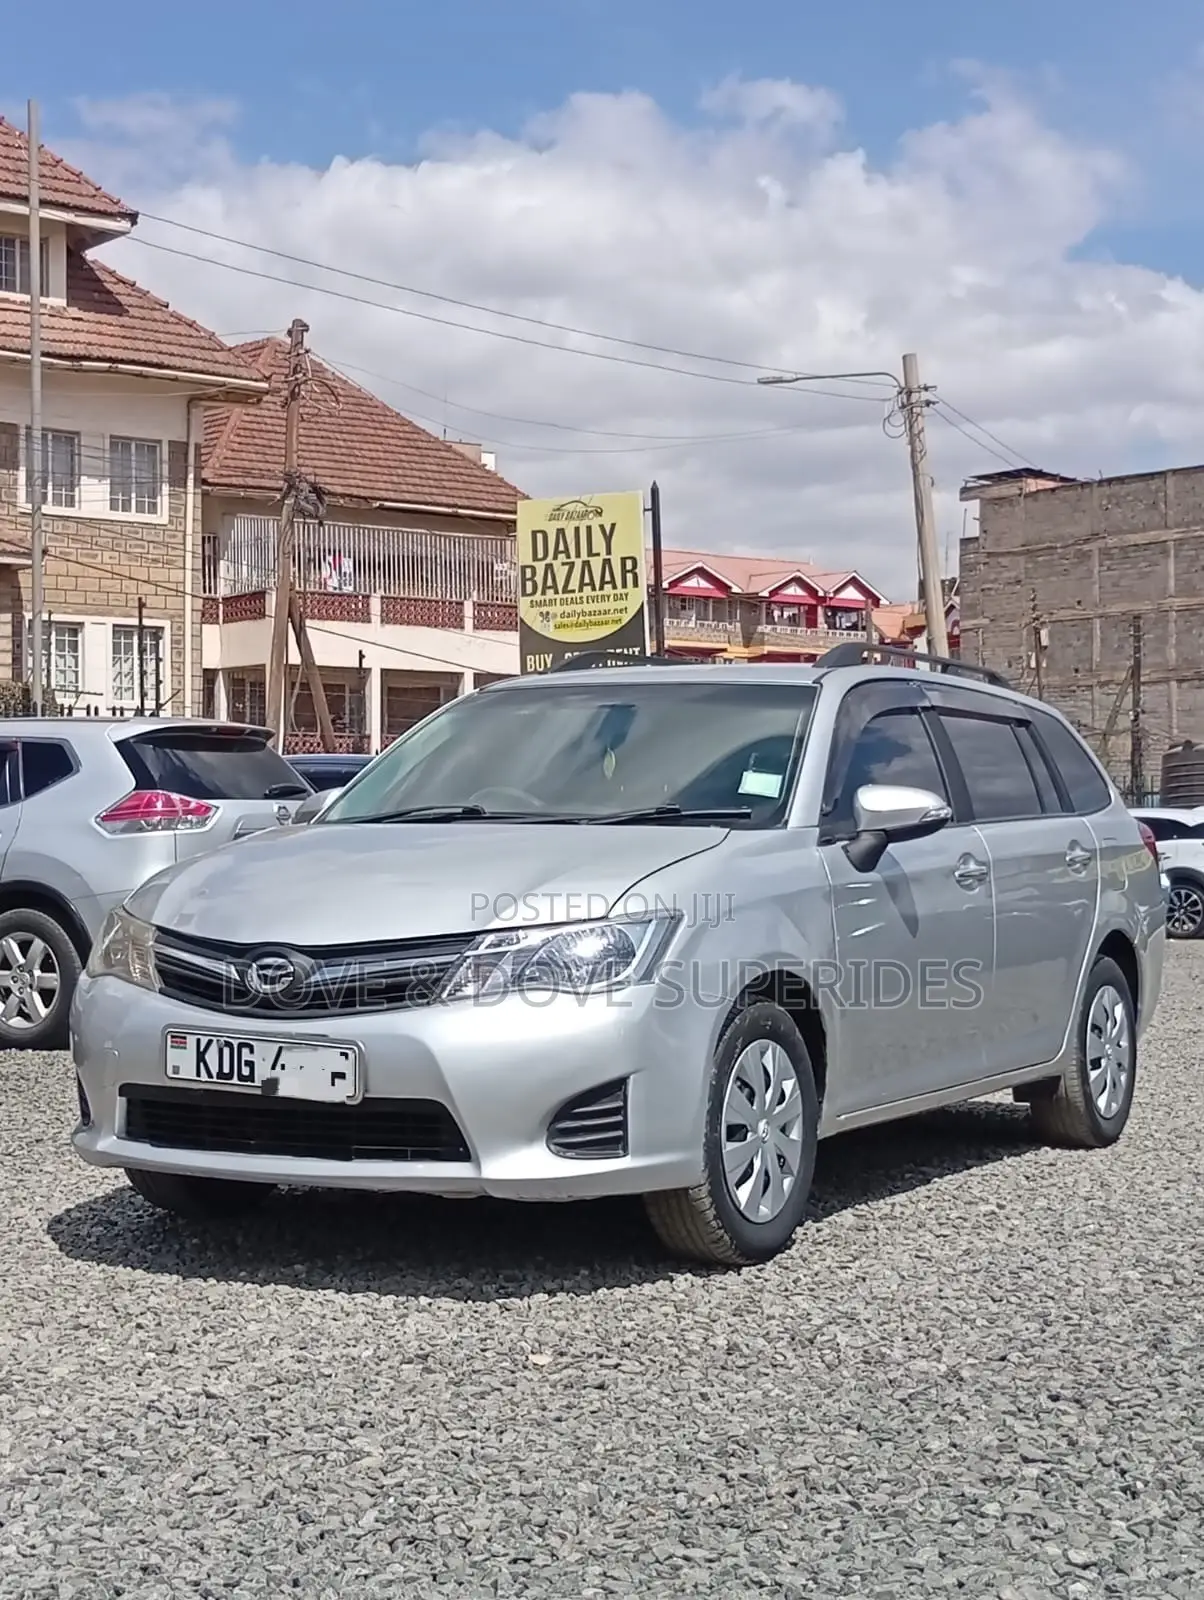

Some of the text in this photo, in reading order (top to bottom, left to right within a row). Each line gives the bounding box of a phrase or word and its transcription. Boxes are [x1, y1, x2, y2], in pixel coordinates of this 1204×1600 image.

[531, 522, 617, 562] DAILY
[520, 556, 640, 598] BAZAAR
[529, 592, 629, 608] SMART DEALS EVERY DAY
[559, 606, 629, 620] dailybazaar.net
[526, 653, 553, 672] BUY
[195, 1037, 256, 1083] KDG
